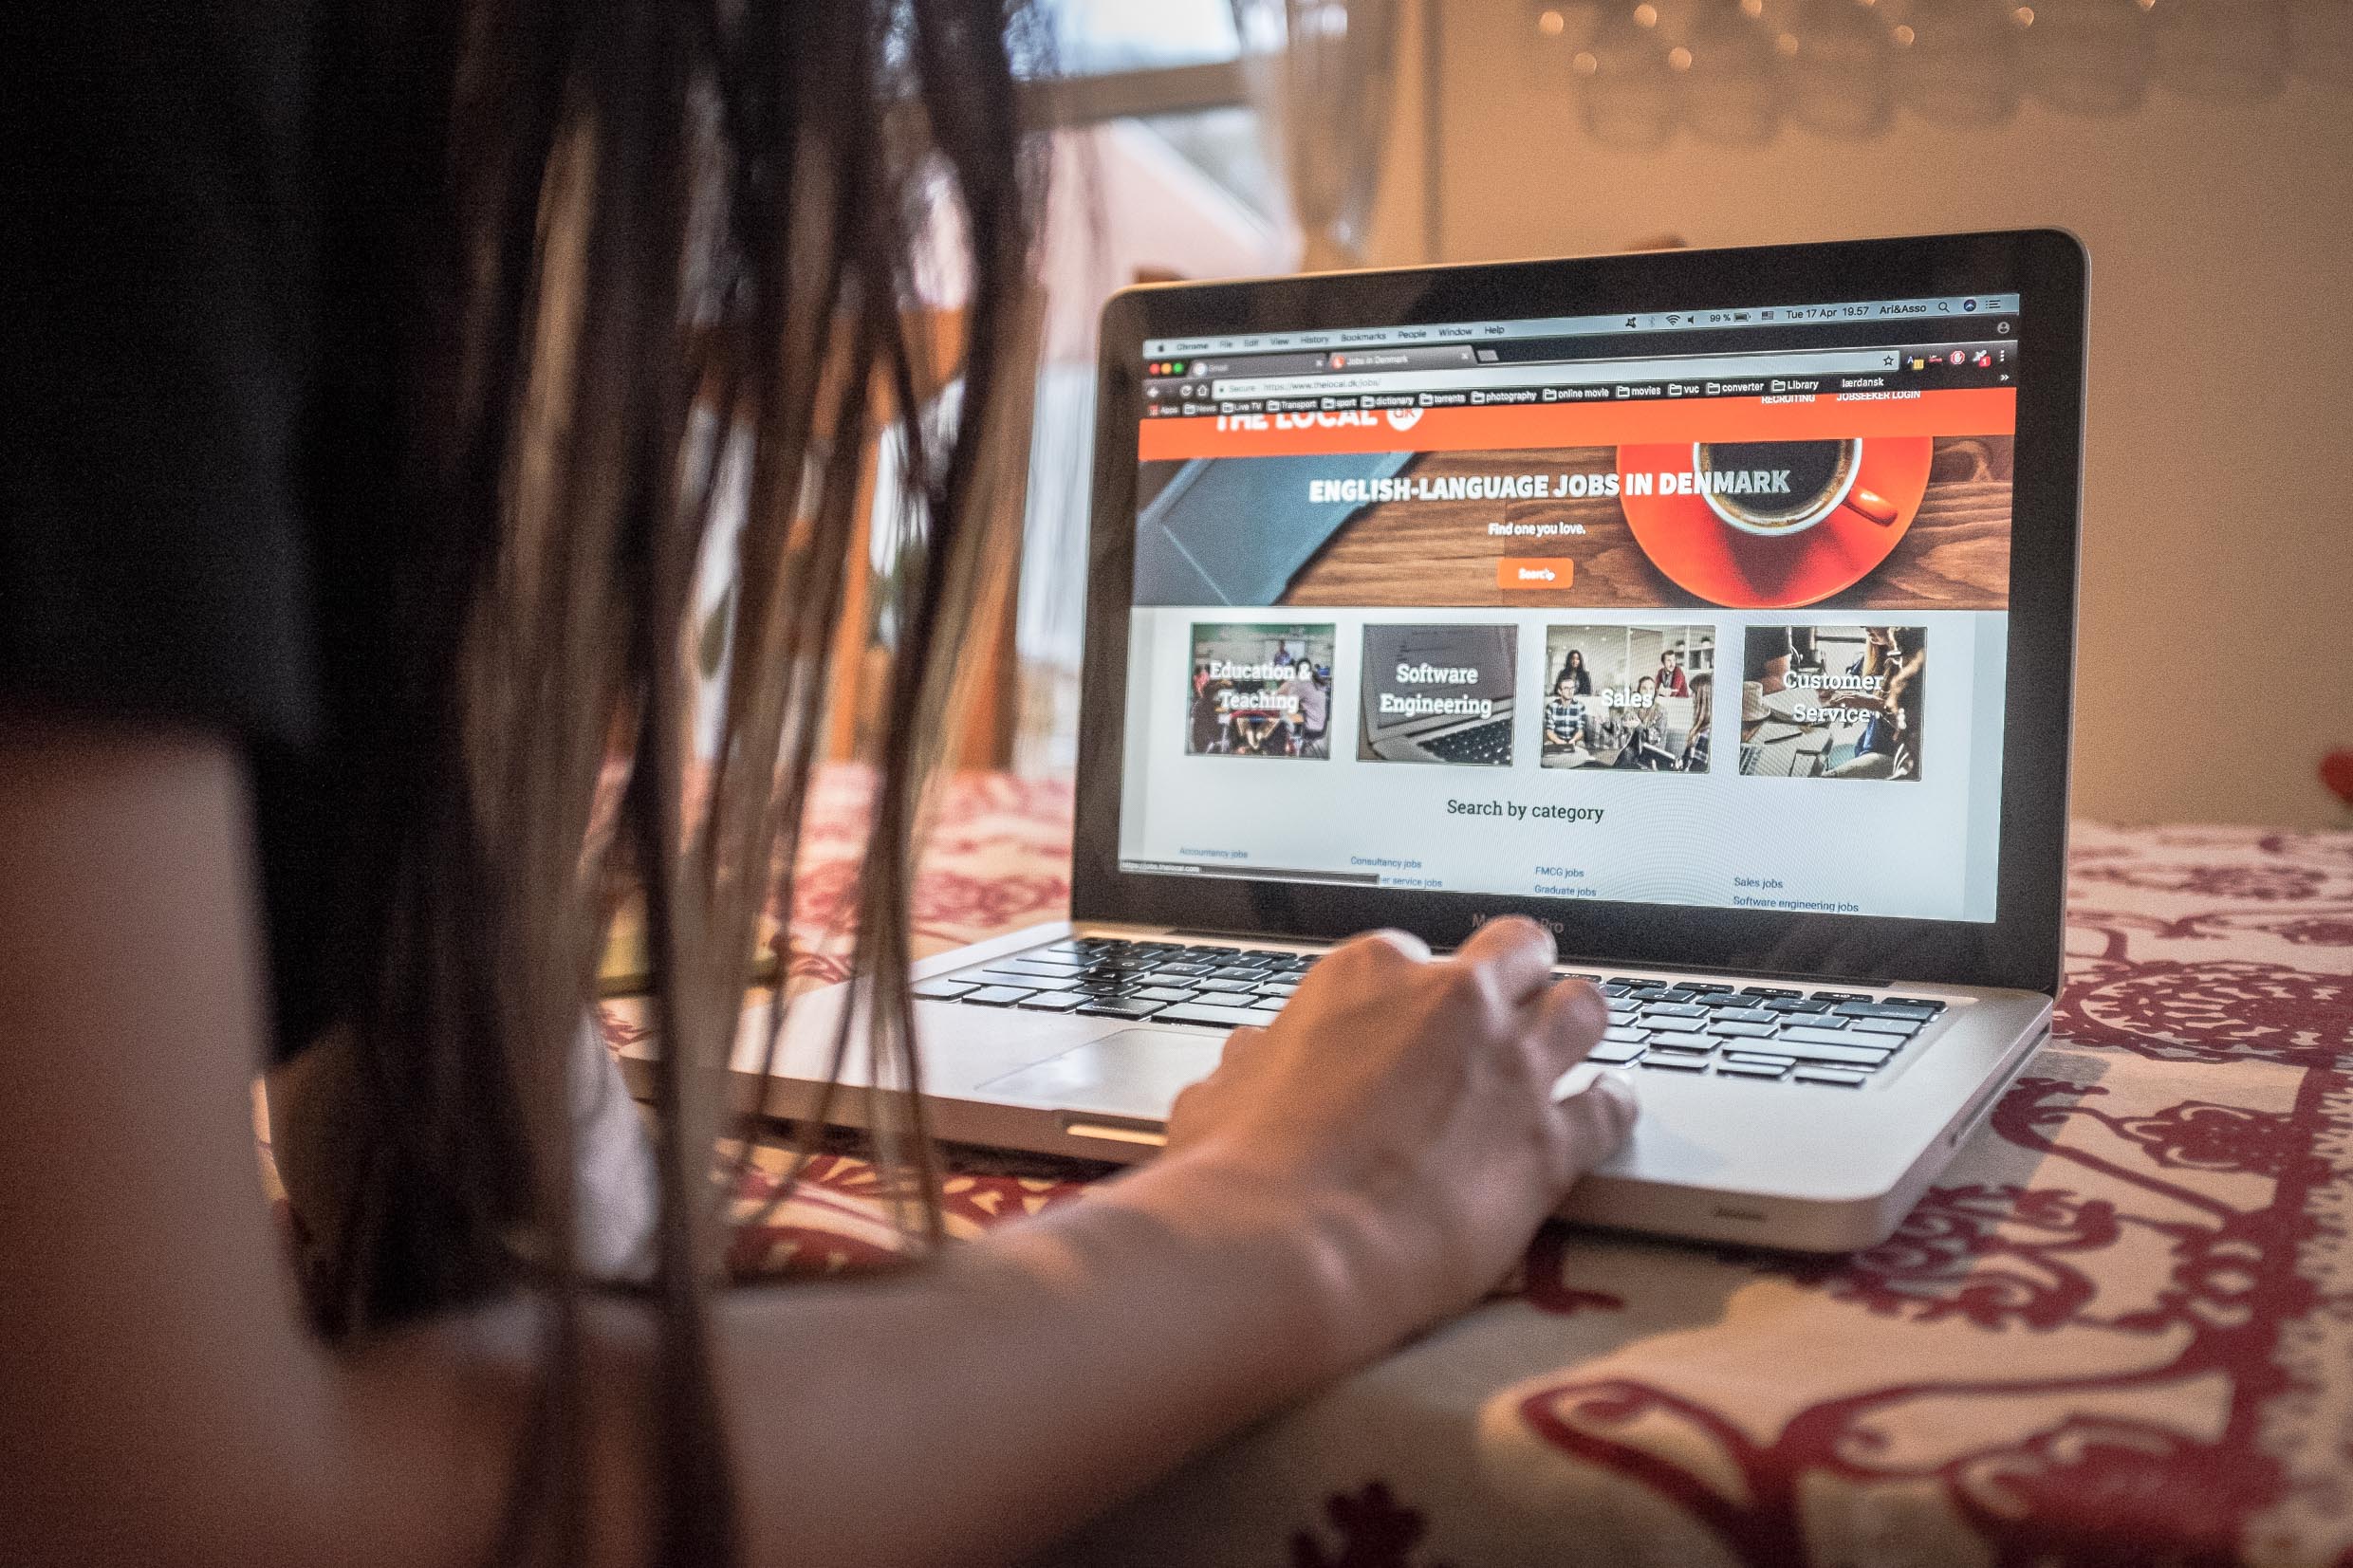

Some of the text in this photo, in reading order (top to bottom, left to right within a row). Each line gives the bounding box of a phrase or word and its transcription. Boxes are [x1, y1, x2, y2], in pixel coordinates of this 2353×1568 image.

[1176, 342, 1209, 351] Chrome
[1270, 337, 1289, 346] View
[1301, 335, 1329, 345] History
[1341, 332, 1386, 341] Bookmarks
[1398, 329, 1427, 340] People
[1438, 327, 1473, 337] Window
[1484, 325, 1505, 336] Help
[1710, 314, 1721, 323] 99
[1723, 313, 1731, 322] %
[1786, 309, 1804, 320] Tue
[1806, 309, 1817, 319] 17
[1819, 308, 1838, 321] Apr
[1843, 306, 1869, 316] 19.57
[1880, 304, 1927, 315] Ari&Asso
[1346, 355, 1408, 365] Jobs in Denmark
[1722, 382, 1764, 393] converter
[1788, 380, 1819, 392] Library
[1842, 378, 1884, 388] lærdansk
[1558, 388, 1609, 398] online movie
[1631, 386, 1660, 397] movies
[1684, 385, 1699, 394] vuc
[1836, 390, 1921, 401] JOBSEEKER LOGIN
[1376, 397, 1415, 407] dictionary
[1434, 394, 1466, 403] torrents
[1486, 391, 1537, 403] photography
[1761, 394, 1816, 404] RECRUITING
[1234, 402, 1250, 411] Live
[1281, 400, 1317, 410] Transport
[1336, 399, 1356, 409] sport
[1160, 406, 1178, 415] Apps
[1276, 410, 1378, 429] LOCAL
[1308, 470, 1791, 503] ENGLISH-LANGUAGE JOBS IN DENMARK
[1488, 522, 1585, 538] Find one you love.
[1209, 660, 1312, 681] Education &
[1396, 663, 1478, 684] Software
[1783, 671, 1884, 692] Customer
[1220, 692, 1299, 711] Teaching
[1601, 688, 1655, 709] Sales
[1380, 692, 1492, 719] Engineering
[1791, 703, 1872, 725] Service
[1447, 799, 1604, 823] Search by category
[1179, 847, 1249, 859] Accountancy jobs
[1350, 856, 1421, 870] Consultancy jobs
[1535, 866, 1584, 879] FMCG jobs
[1392, 877, 1422, 887] service
[1424, 878, 1442, 889] jobs
[1733, 876, 1783, 890] Sales jobs
[1534, 884, 1597, 898] Graduate jobs
[1733, 895, 1859, 913] Software engineering jobs
